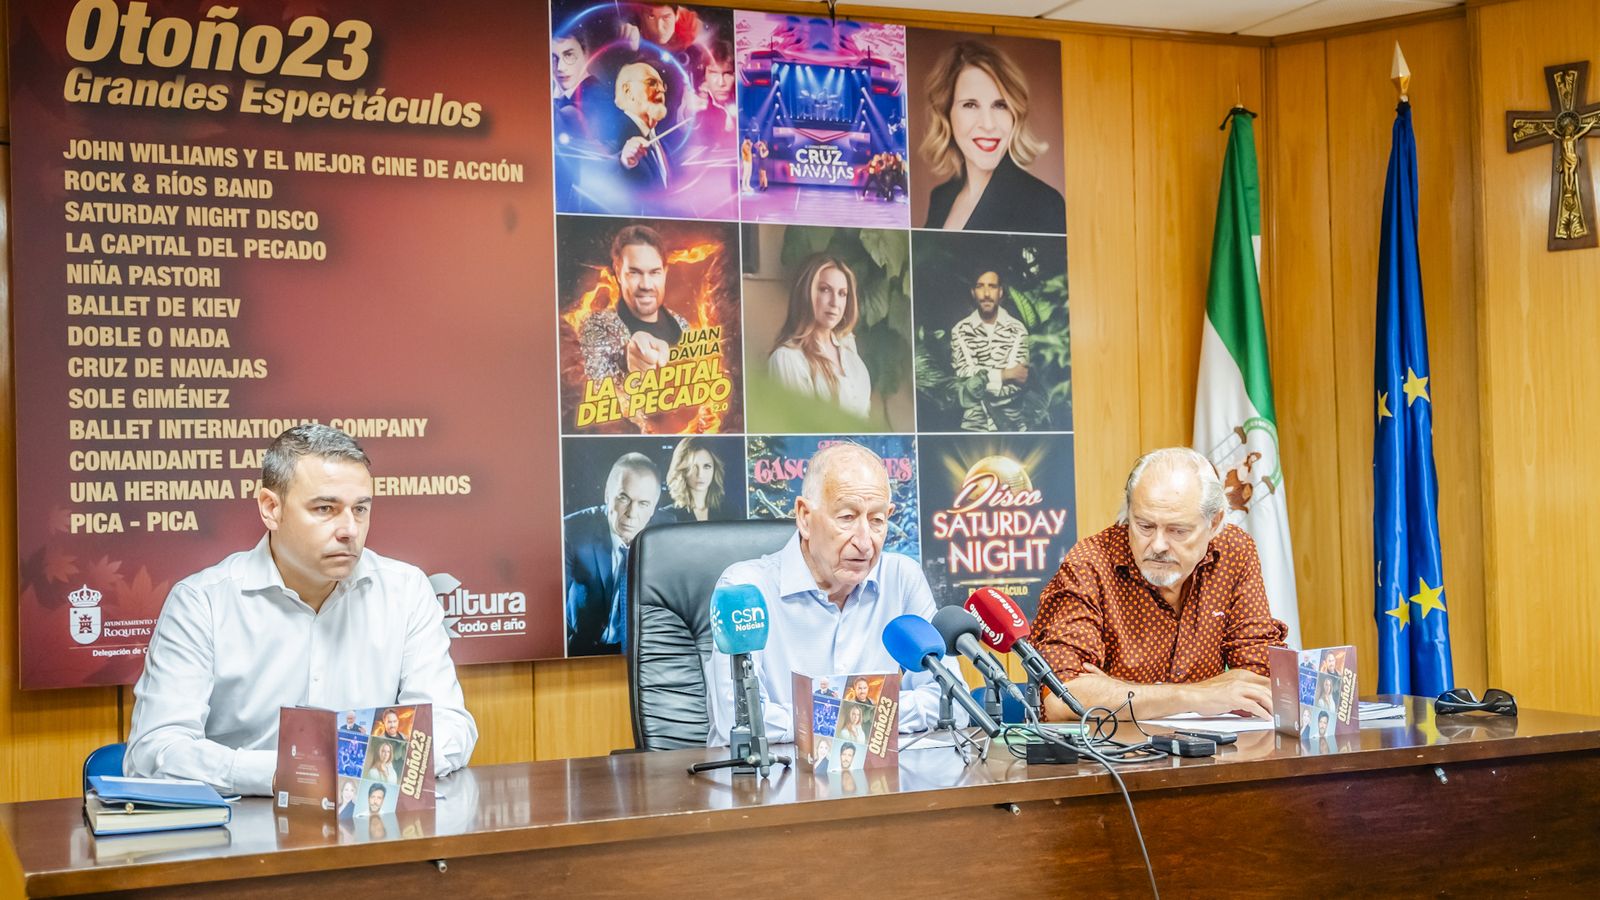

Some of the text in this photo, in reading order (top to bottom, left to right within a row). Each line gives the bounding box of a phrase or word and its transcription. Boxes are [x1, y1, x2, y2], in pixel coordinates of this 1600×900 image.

[66, 0, 373, 81] Otoño23
[64, 66, 482, 128] Grandes Espectáculos
[63, 139, 524, 182] JOHN WILLIAMS Y EL MEJOR CINE DE ACCIÓN
[796, 148, 848, 166] CRUZ
[64, 170, 273, 199] ROCK & RÍOS BAND
[789, 163, 854, 183] NAVAJAS
[65, 201, 318, 231] SATURDAY NIGHT DISCO
[66, 232, 327, 260] LA CAPITAL DEL PECADO
[67, 260, 220, 288] NIÑA PASTORI
[68, 295, 241, 318] BALLET DE KIEV
[68, 326, 230, 348] DOBLE O NADA
[680, 327, 720, 345] JUAN
[68, 357, 268, 379] CRUZ DE NAVAJAS
[584, 358, 724, 402] LA CAPITAL
[68, 384, 230, 409] SOLE GIMÉNEZ
[576, 378, 732, 427] DEL PECADO
[70, 419, 152, 440] BALLET
[70, 449, 223, 472] COMANDANTE
[70, 481, 118, 502] UNA
[124, 480, 234, 501] HERMANA
[371, 476, 471, 496] ERMANOS
[947, 472, 1042, 514] Disco
[70, 512, 124, 534] PICA
[147, 510, 199, 532] PICA
[933, 510, 1067, 538] SATURDAY
[950, 538, 1050, 574] NIGHT
[458, 618, 526, 632] todo el año
[92, 648, 130, 657] Delegación
[868, 696, 893, 755] Otoño23
[401, 730, 426, 796] Otoño23
